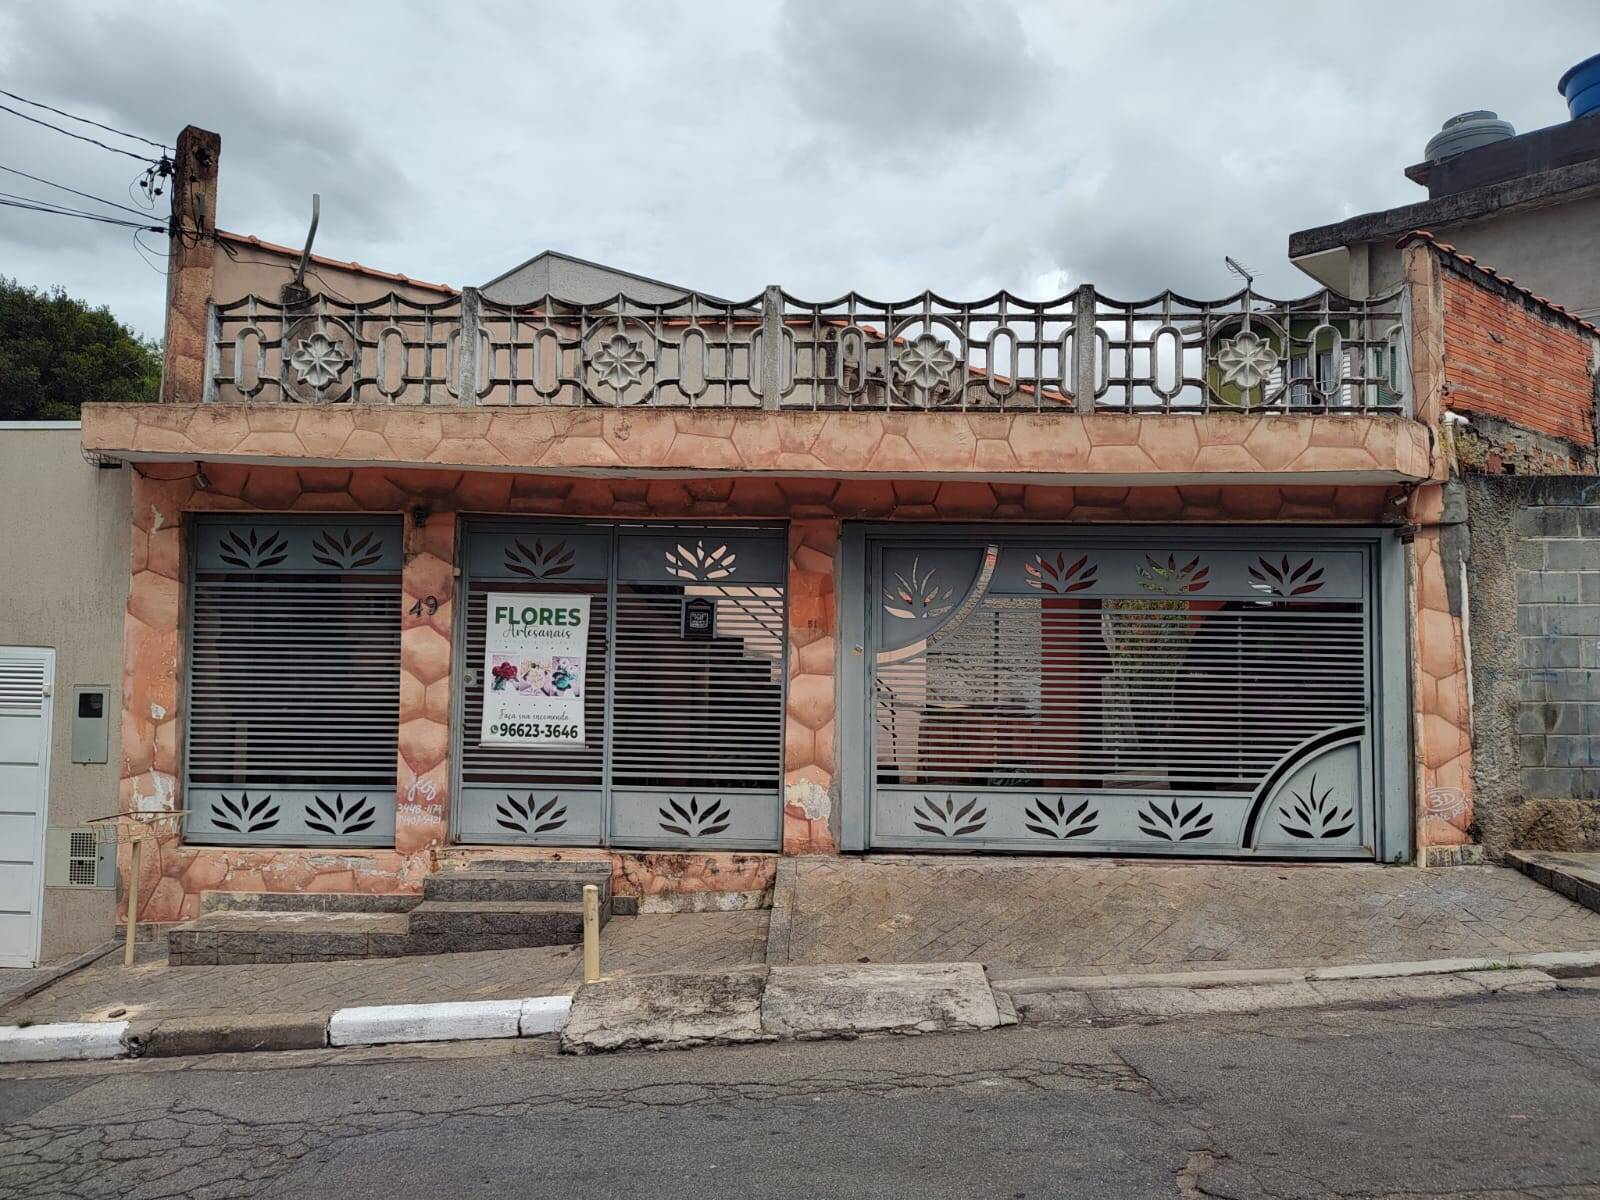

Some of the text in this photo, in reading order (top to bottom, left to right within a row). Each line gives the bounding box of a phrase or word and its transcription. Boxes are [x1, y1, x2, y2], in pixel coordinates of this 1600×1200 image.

[409, 595, 437, 618] 49
[495, 606, 581, 626] FLORES
[503, 623, 572, 639] Artesanais
[499, 708, 516, 720] Faça
[533, 710, 569, 721] encomenda
[500, 722, 579, 739] 96623-3646
